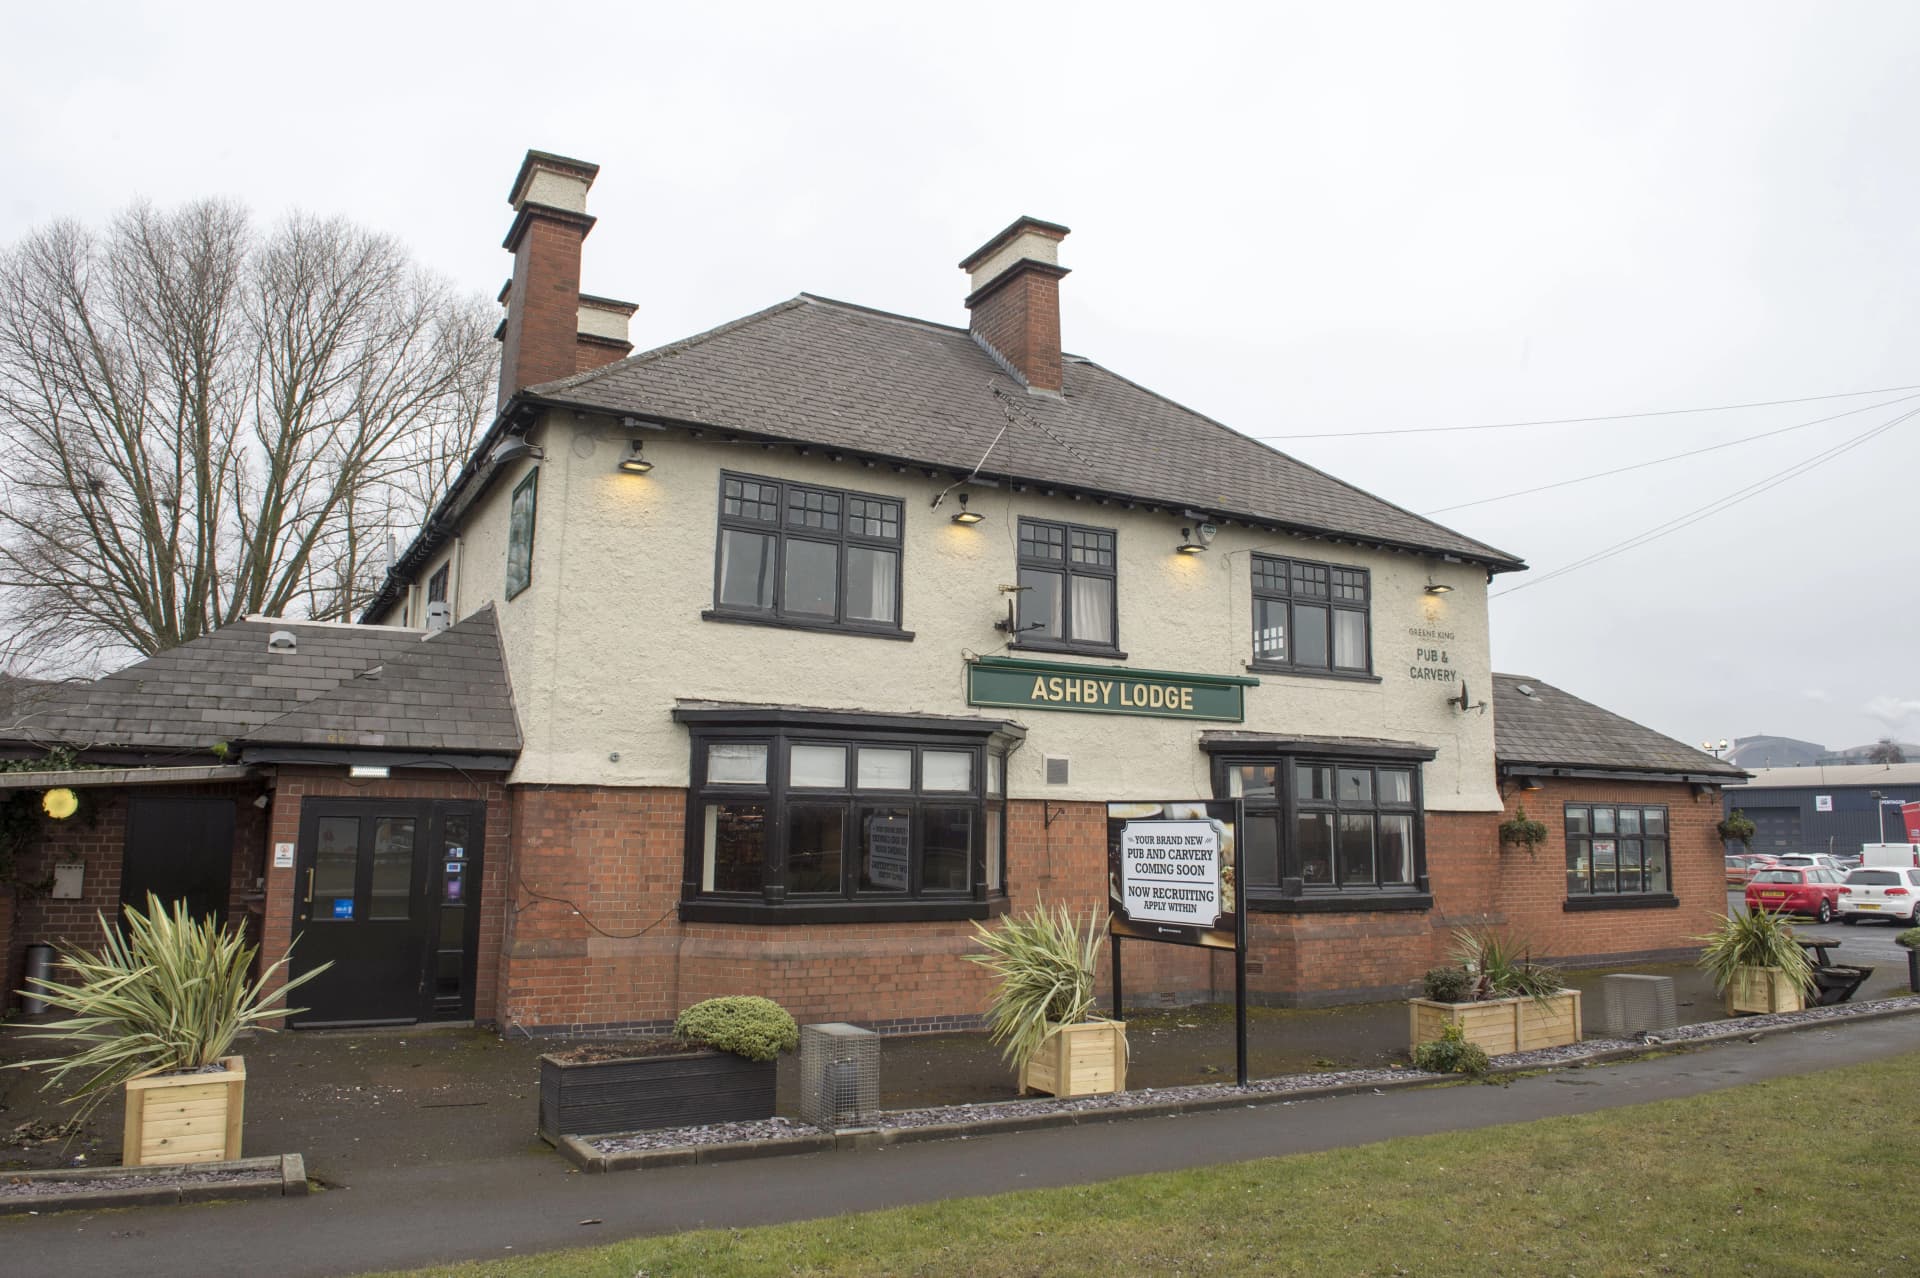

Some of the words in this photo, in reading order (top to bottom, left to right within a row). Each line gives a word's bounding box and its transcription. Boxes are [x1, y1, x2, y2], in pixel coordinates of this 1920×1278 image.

[1409, 628, 1436, 638] GREENE
[1438, 631, 1455, 640] KING
[1417, 648, 1438, 662] PUB
[1441, 651, 1448, 664] &
[1410, 666, 1457, 682] CARVERY
[1031, 675, 1113, 705] ASHBY
[1120, 682, 1194, 710] LODGE
[1135, 835, 1155, 844] YOUR
[1156, 836, 1183, 845] BRAND
[1184, 836, 1203, 845] NEW
[1127, 848, 1144, 859] PUB
[1146, 848, 1166, 860] AND
[1168, 849, 1213, 861] CARVERY
[1135, 862, 1174, 875] COMING
[1176, 864, 1205, 876] SOON
[1128, 886, 1151, 898] NOW
[1152, 887, 1214, 902] RECRUITING
[1143, 900, 1166, 911] APPLY
[1167, 902, 1197, 913] WITHIN
